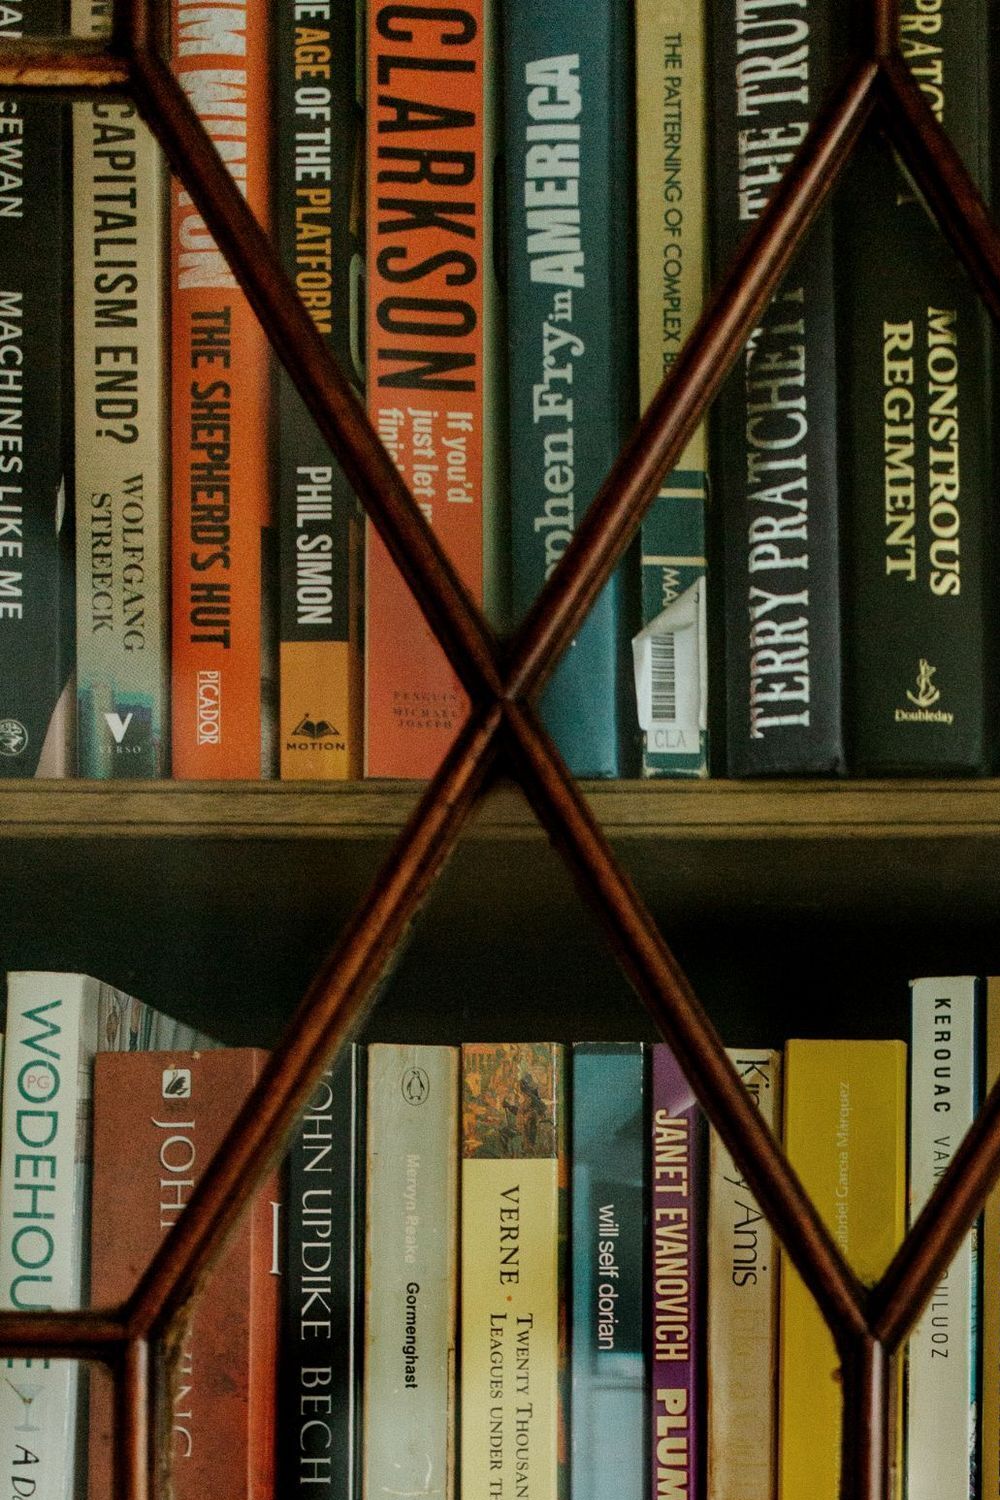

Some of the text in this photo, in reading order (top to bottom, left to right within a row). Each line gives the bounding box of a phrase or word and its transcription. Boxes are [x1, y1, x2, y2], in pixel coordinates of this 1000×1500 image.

[376, 5, 478, 392] CLARKSON
[525, 54, 585, 424] Fry AMERICA
[663, 33, 682, 342] THE PATTERNING OF COMPLEX
[93, 102, 139, 444] CAPITALISM END?
[190, 306, 231, 369] THE
[884, 321, 917, 581] REGIMENT
[928, 307, 961, 596] MONSTROUS
[91, 493, 114, 634] STREECK
[122, 473, 145, 652] WOLFGANG
[190, 583, 231, 649] HUT
[297, 466, 333, 624] PHIL SIMON
[197, 671, 221, 745] PICADOR
[750, 590, 810, 738] TERRY
[895, 709, 953, 723] Doubleday
[286, 742, 346, 751] MOTION
[933, 998, 951, 1113] KEROUAC
[653, 1110, 688, 1196] JANET
[301, 1190, 333, 1340] UPDIKE
[499, 1184, 520, 1286] VERNE
[598, 1205, 619, 1350] will self dorian
[654, 1207, 690, 1361] EVANOVICH
[402, 1282, 420, 1390] Gormenghast
[13, 1445, 39, 1464] A
[300, 1366, 332, 1484] BECH
